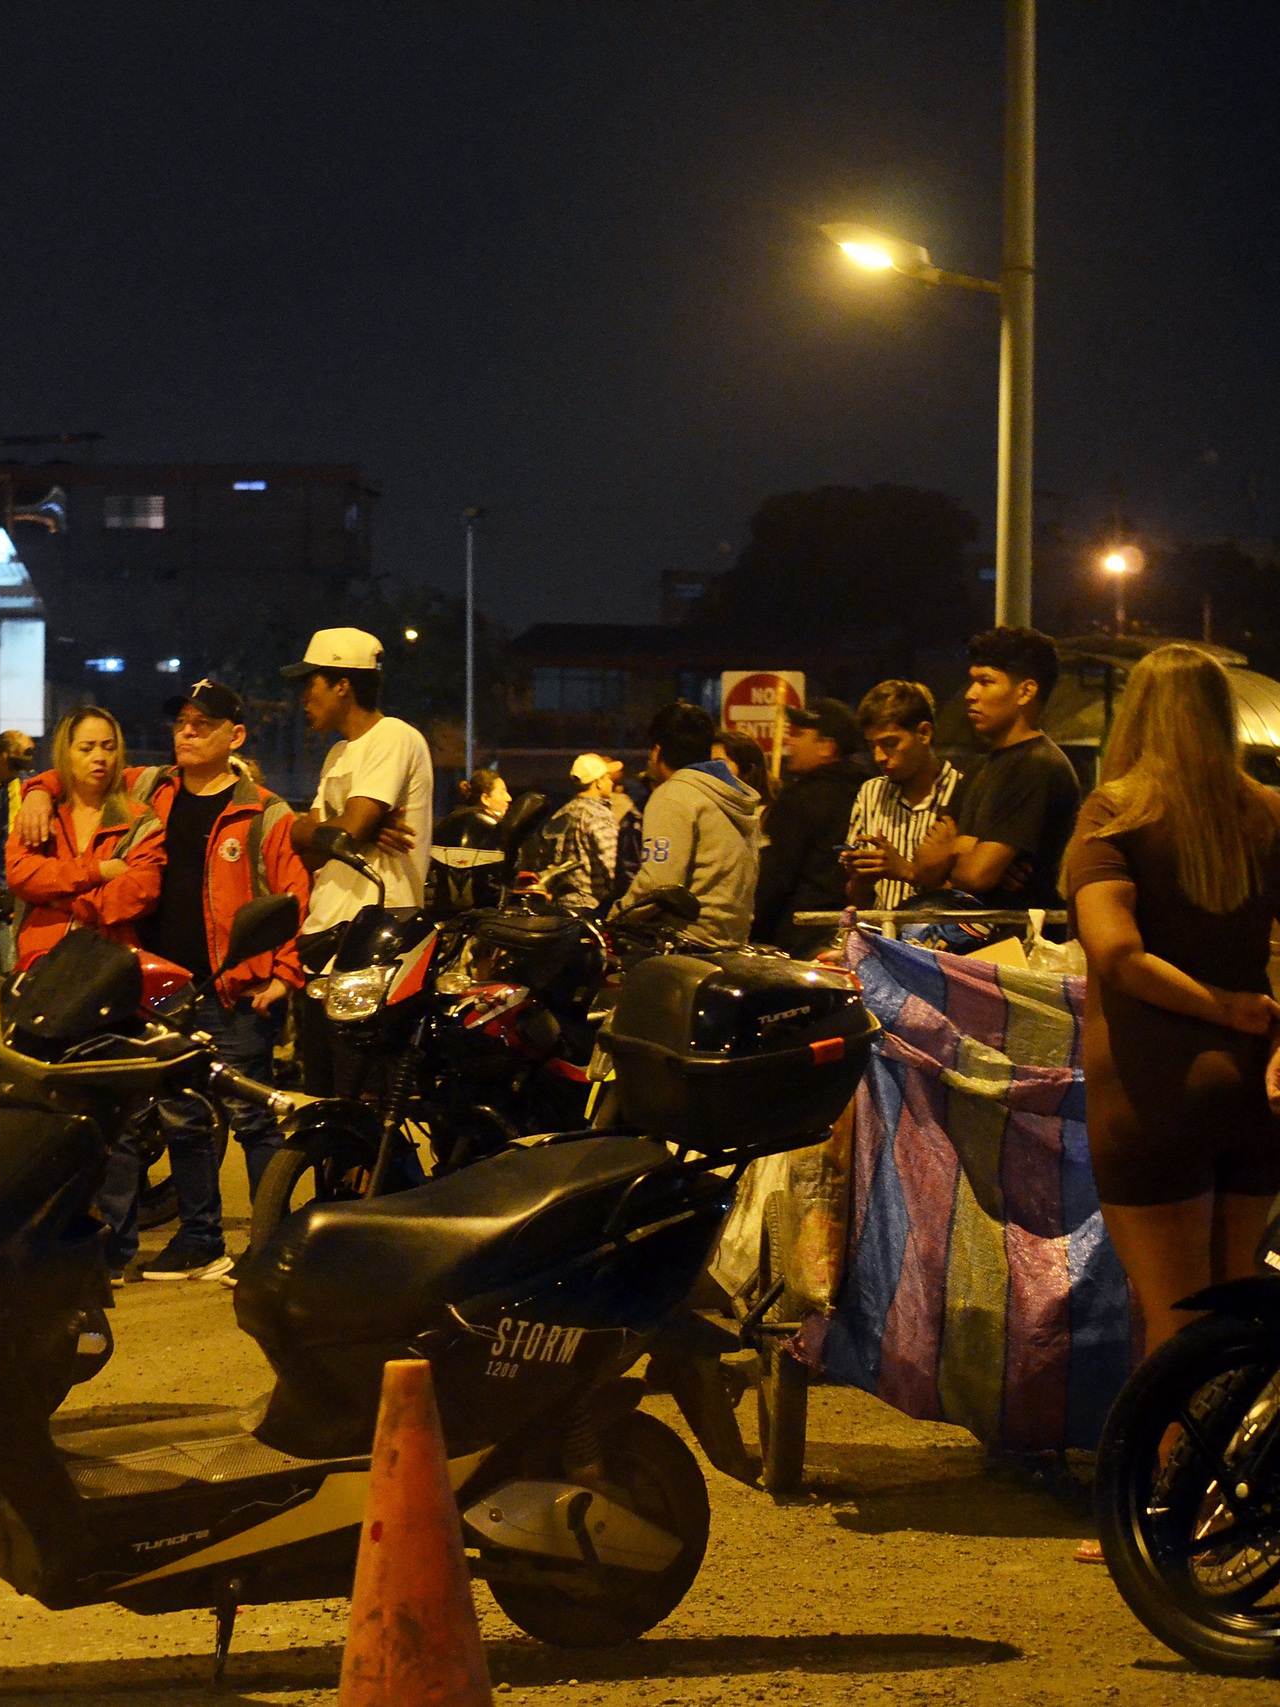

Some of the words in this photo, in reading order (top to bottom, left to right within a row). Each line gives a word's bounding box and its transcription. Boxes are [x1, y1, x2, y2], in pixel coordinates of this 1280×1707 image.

[750, 687, 776, 704] NO
[490, 1316, 586, 1364] STORM
[484, 1360, 519, 1378] 1200
